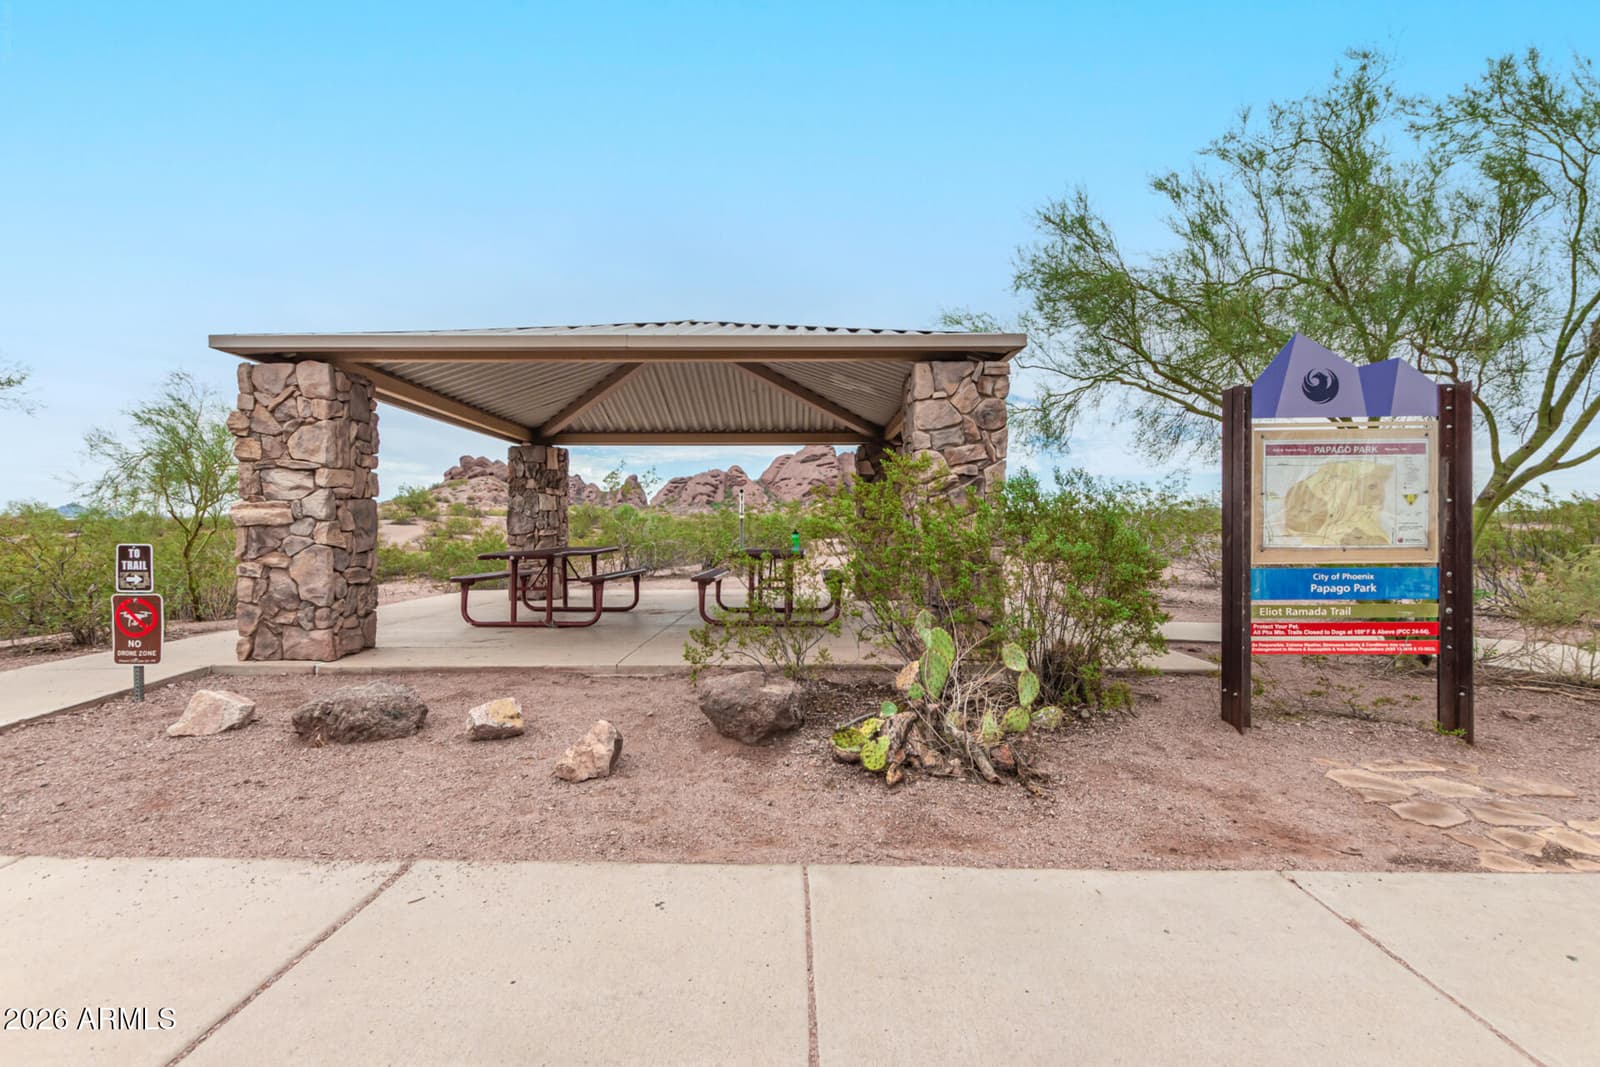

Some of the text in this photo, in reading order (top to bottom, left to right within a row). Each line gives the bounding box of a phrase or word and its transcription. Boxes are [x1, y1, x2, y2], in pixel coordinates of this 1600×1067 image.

[128, 549, 140, 558] TO
[121, 561, 148, 570] TRAIL
[1312, 573, 1328, 582] City
[1310, 583, 1376, 595] Papago Park
[1260, 606, 1352, 616] Eliot Ramada Trail
[128, 640, 142, 648] NO
